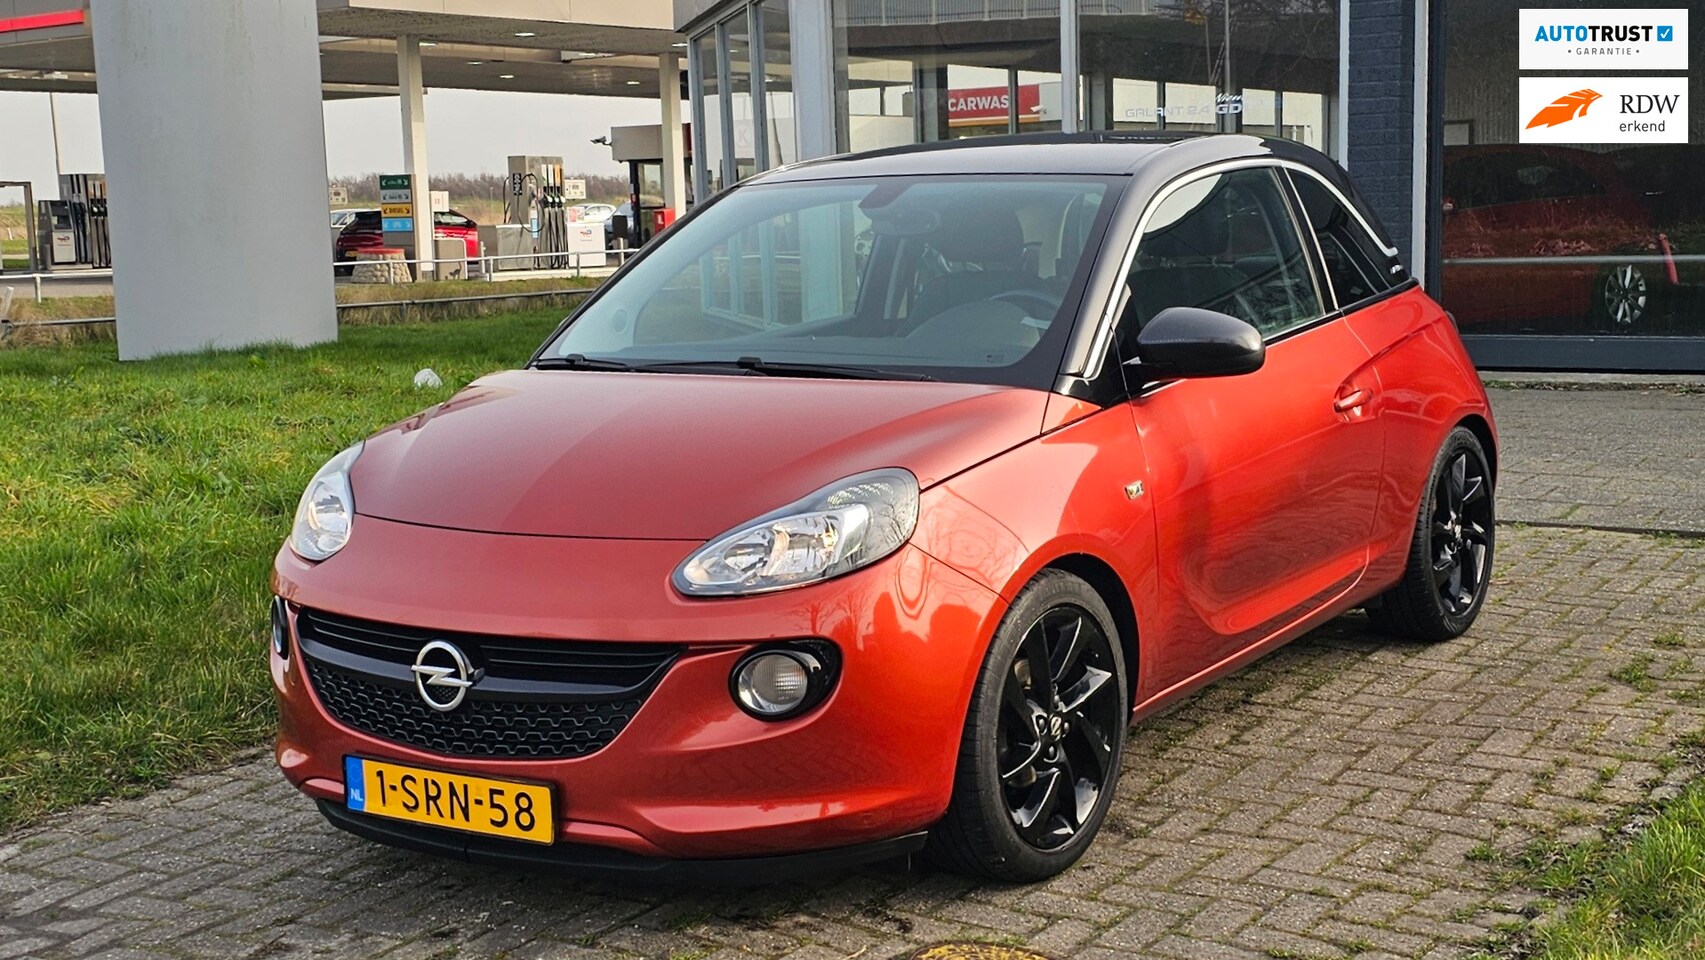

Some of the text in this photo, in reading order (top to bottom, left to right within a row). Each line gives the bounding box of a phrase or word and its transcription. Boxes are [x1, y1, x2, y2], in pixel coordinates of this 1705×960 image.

[948, 95, 1009, 112] CARWAS
[1126, 103, 1243, 118] GALANT 2.4 GD
[350, 787, 363, 801] NL
[376, 770, 536, 832] 1-SRN-58
